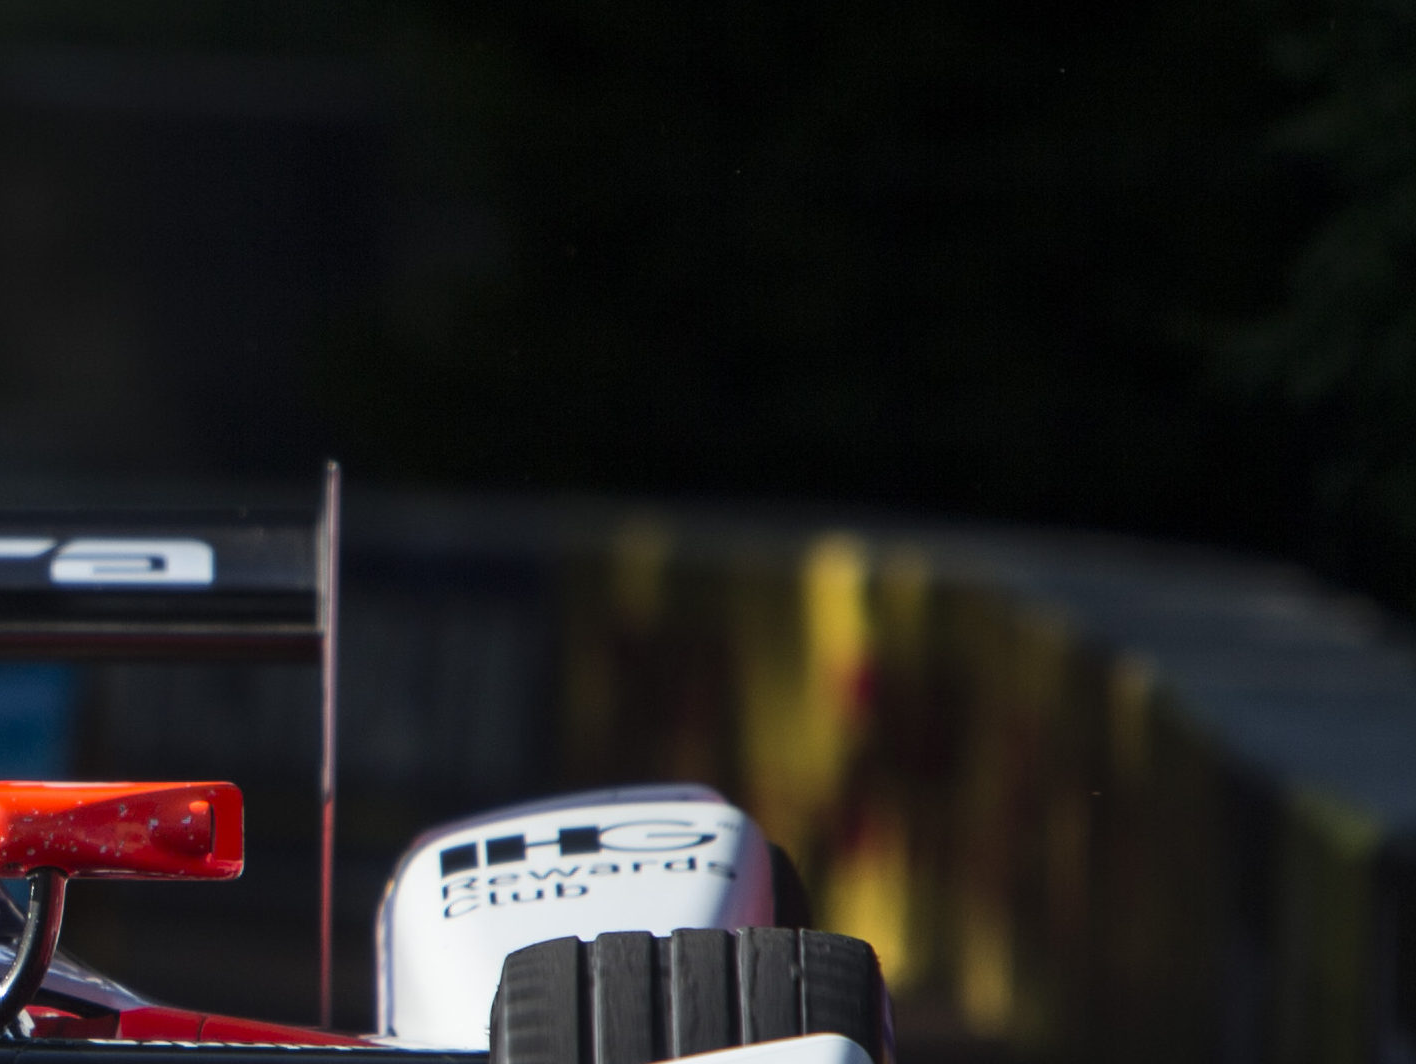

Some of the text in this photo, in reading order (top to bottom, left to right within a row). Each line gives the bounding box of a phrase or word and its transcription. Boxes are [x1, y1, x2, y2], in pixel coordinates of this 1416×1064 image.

[440, 819, 718, 877] IHG
[442, 856, 738, 900] Rewards
[444, 882, 590, 919] Club
